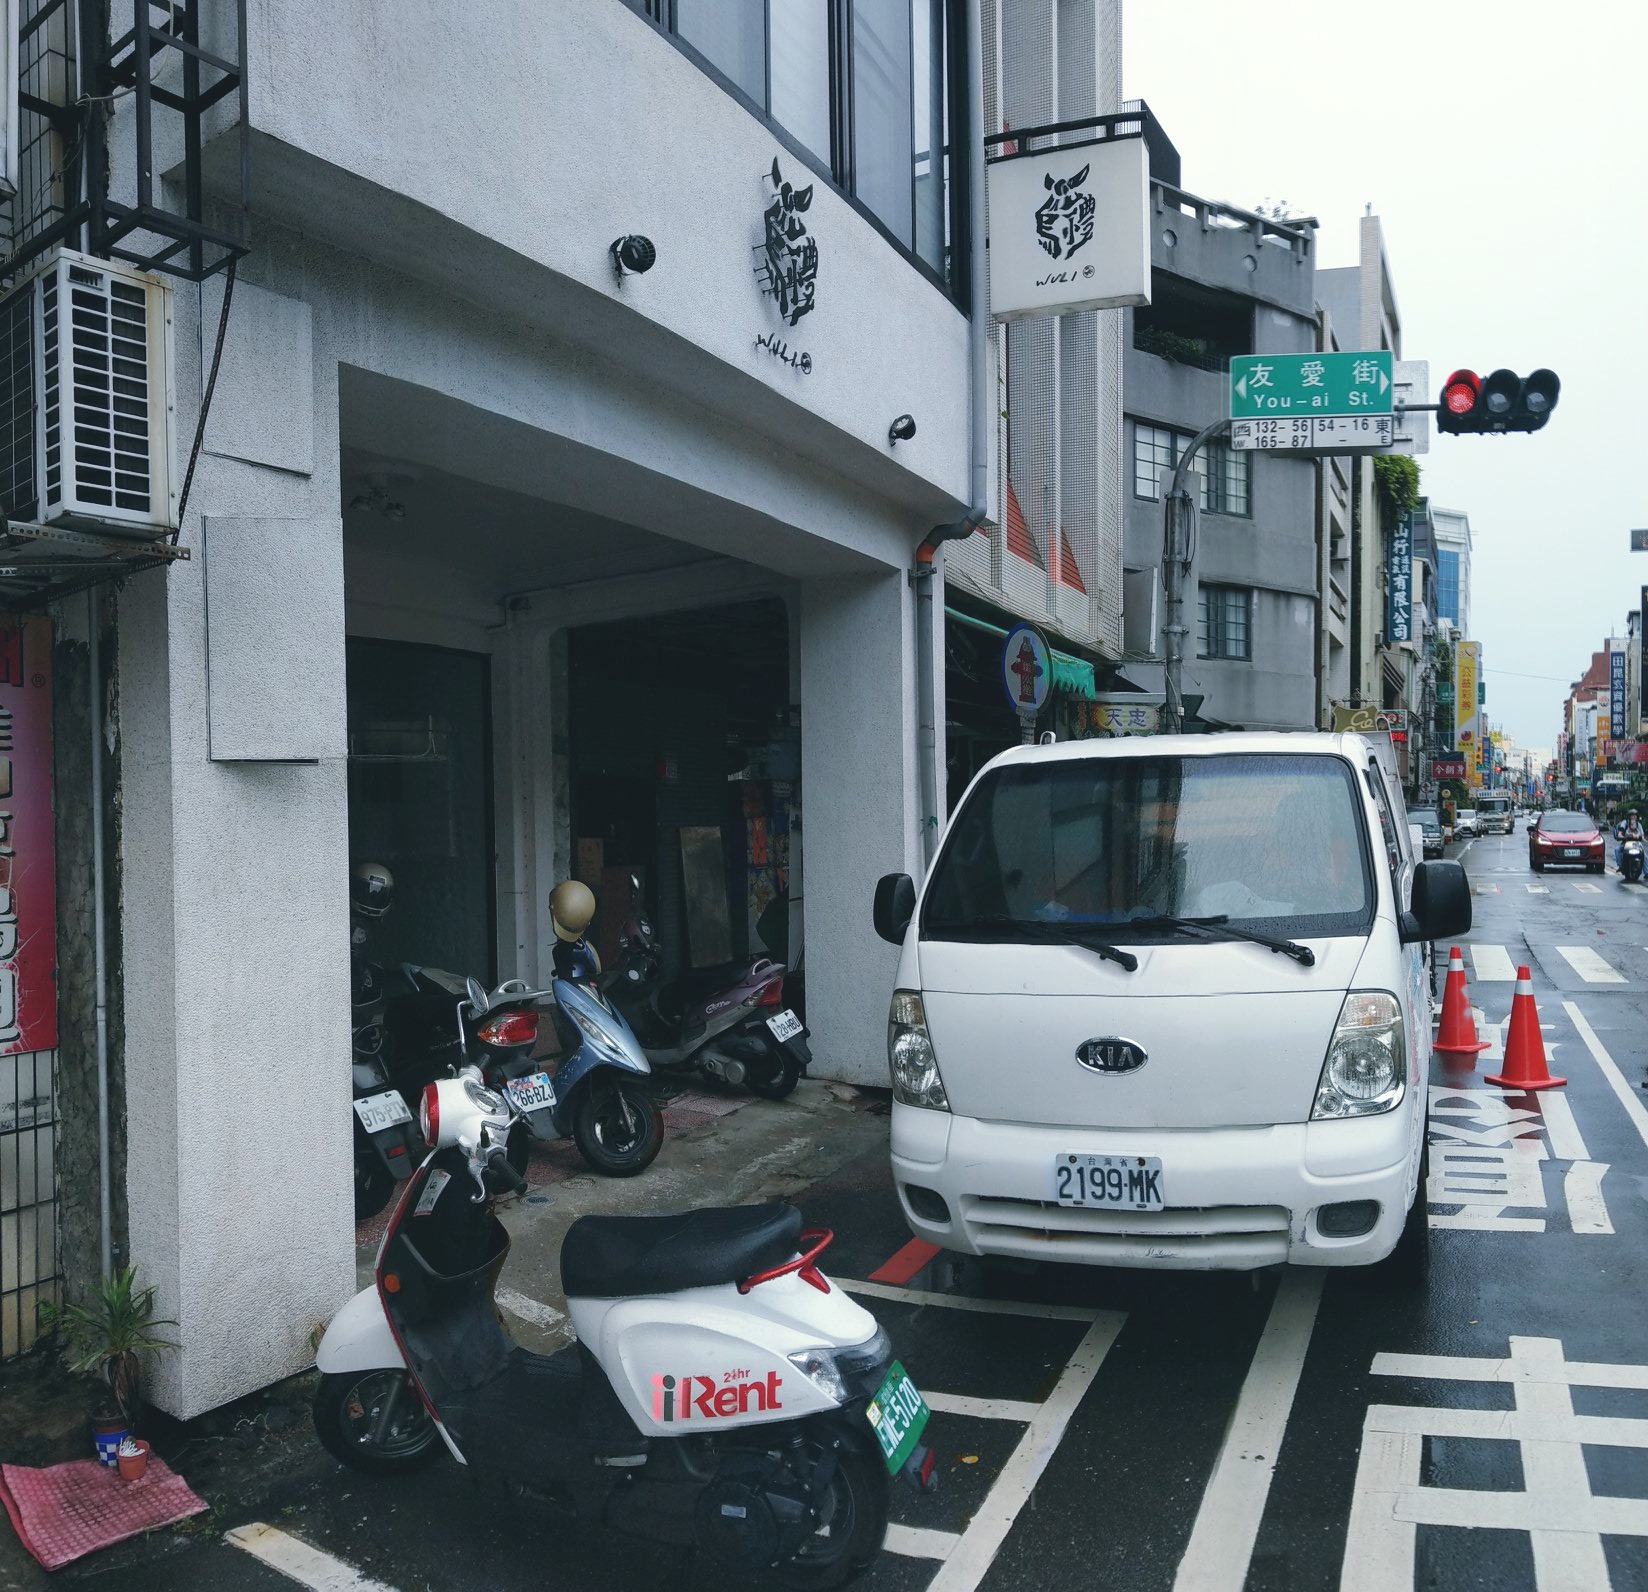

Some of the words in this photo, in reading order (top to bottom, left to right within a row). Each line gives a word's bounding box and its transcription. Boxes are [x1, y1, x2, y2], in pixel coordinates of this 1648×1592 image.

[1036, 270, 1078, 287] WULI
[1249, 359, 1379, 389] 友愛街
[1348, 390, 1374, 407] St.
[1374, 418, 1391, 434] 東
[1087, 1045, 1136, 1067] KIA
